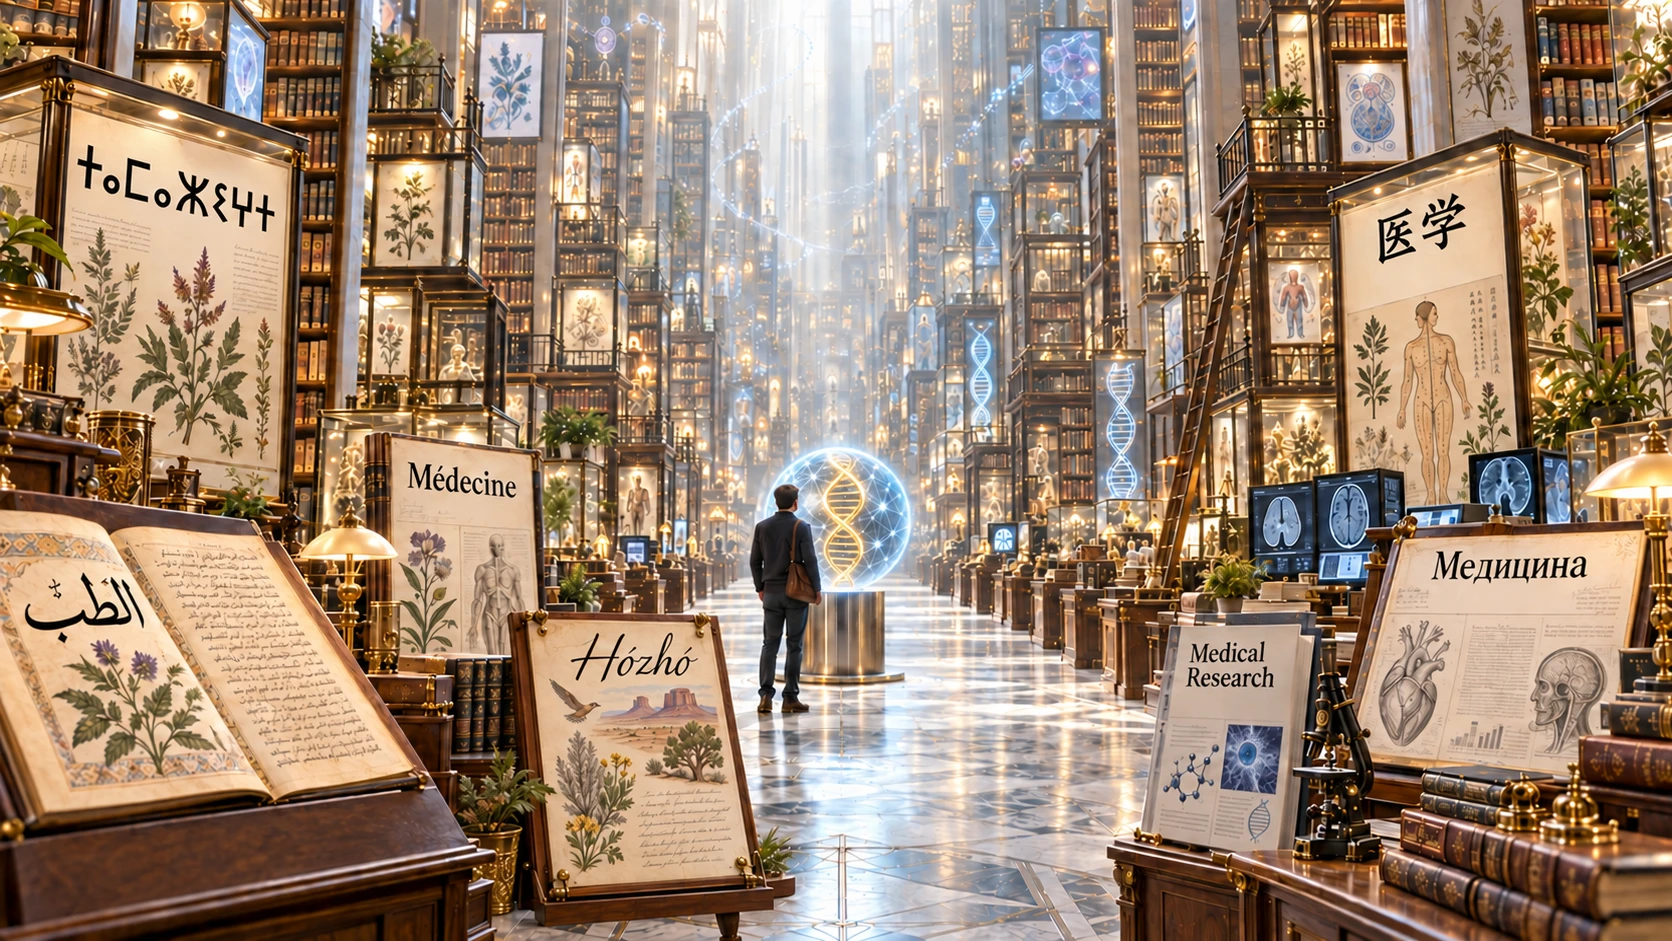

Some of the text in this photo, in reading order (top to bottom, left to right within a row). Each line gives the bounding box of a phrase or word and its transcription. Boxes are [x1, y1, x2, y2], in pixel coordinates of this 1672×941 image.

[1377, 192, 1467, 265] 医学
[407, 461, 518, 499] Médecine
[1431, 550, 1588, 584] Медицина
[570, 632, 699, 683] Hózhó
[1189, 640, 1265, 663] Medical
[1186, 666, 1275, 688] Research
